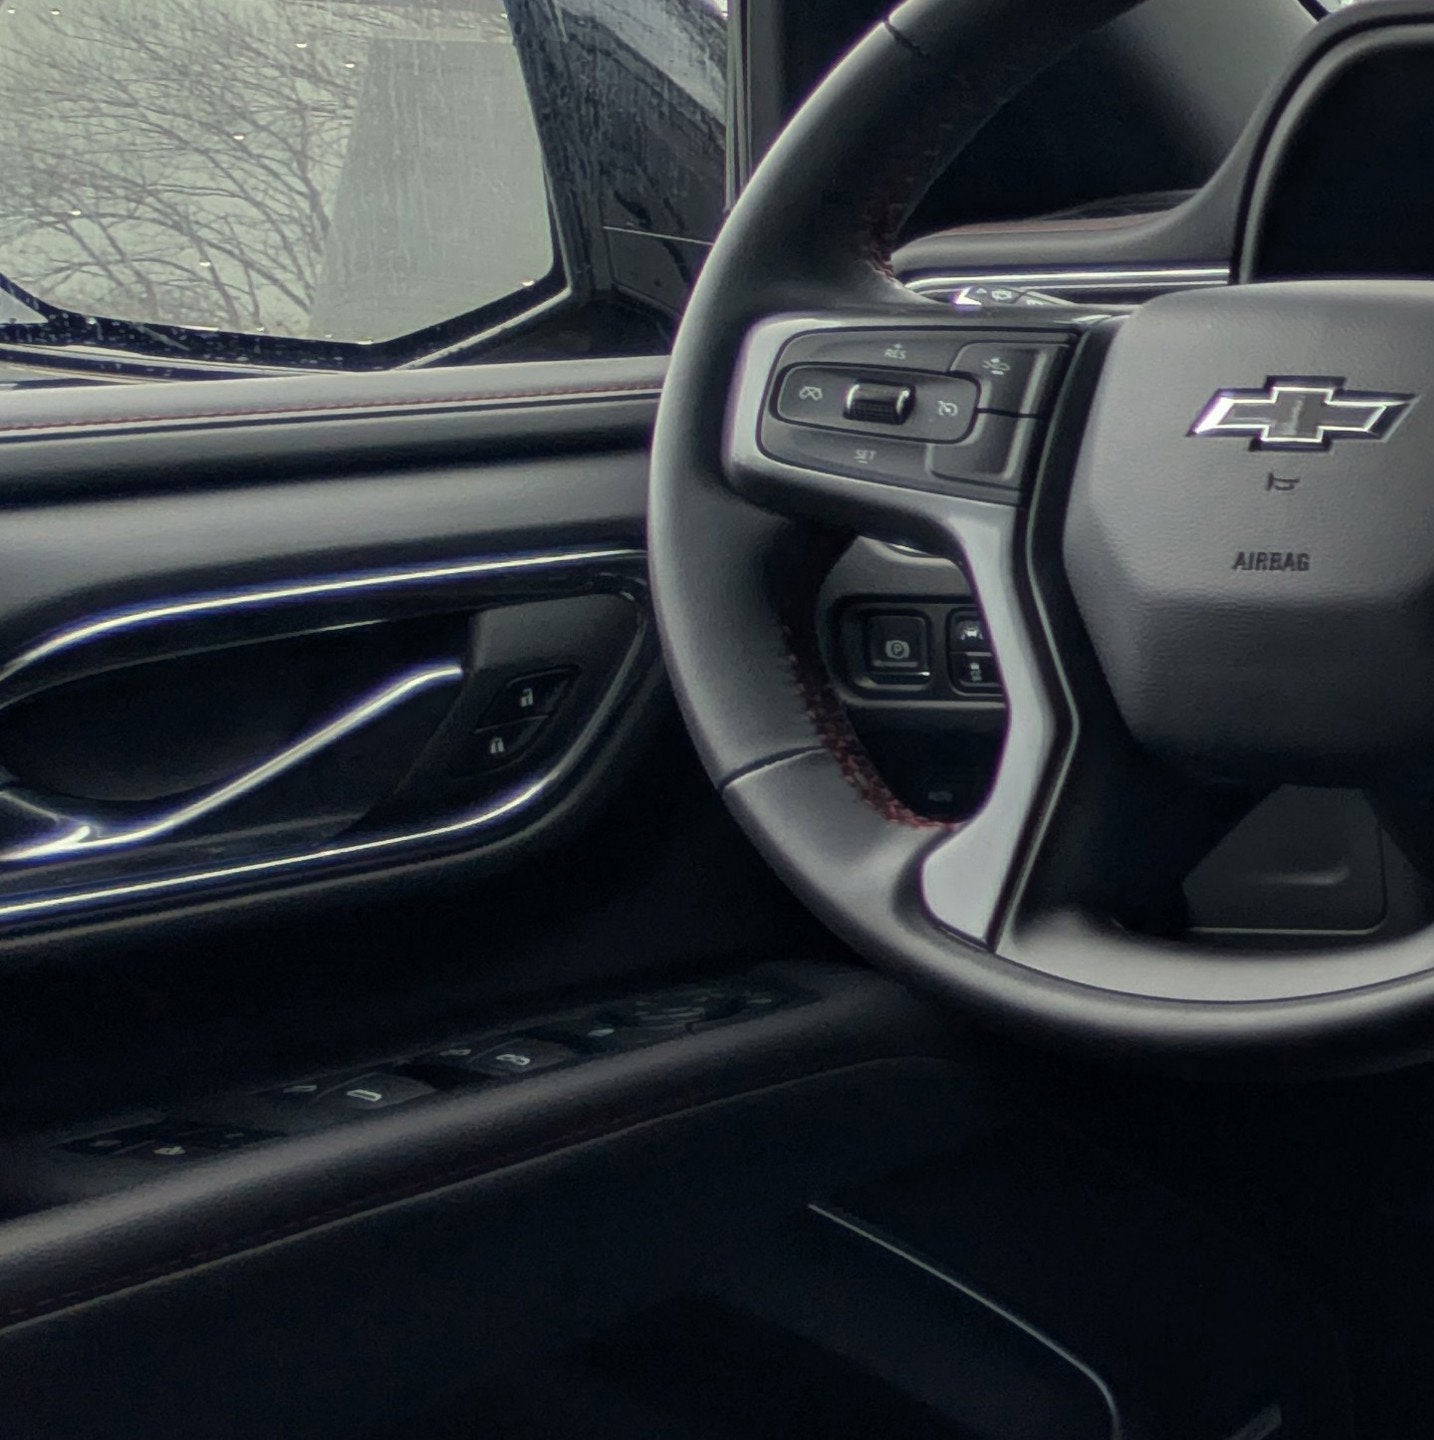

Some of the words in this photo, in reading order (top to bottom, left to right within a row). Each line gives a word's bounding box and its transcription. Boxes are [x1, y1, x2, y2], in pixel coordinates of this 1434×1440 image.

[884, 348, 907, 360] RES
[854, 448, 877, 461] SET
[1231, 551, 1311, 572] AIRBAG
